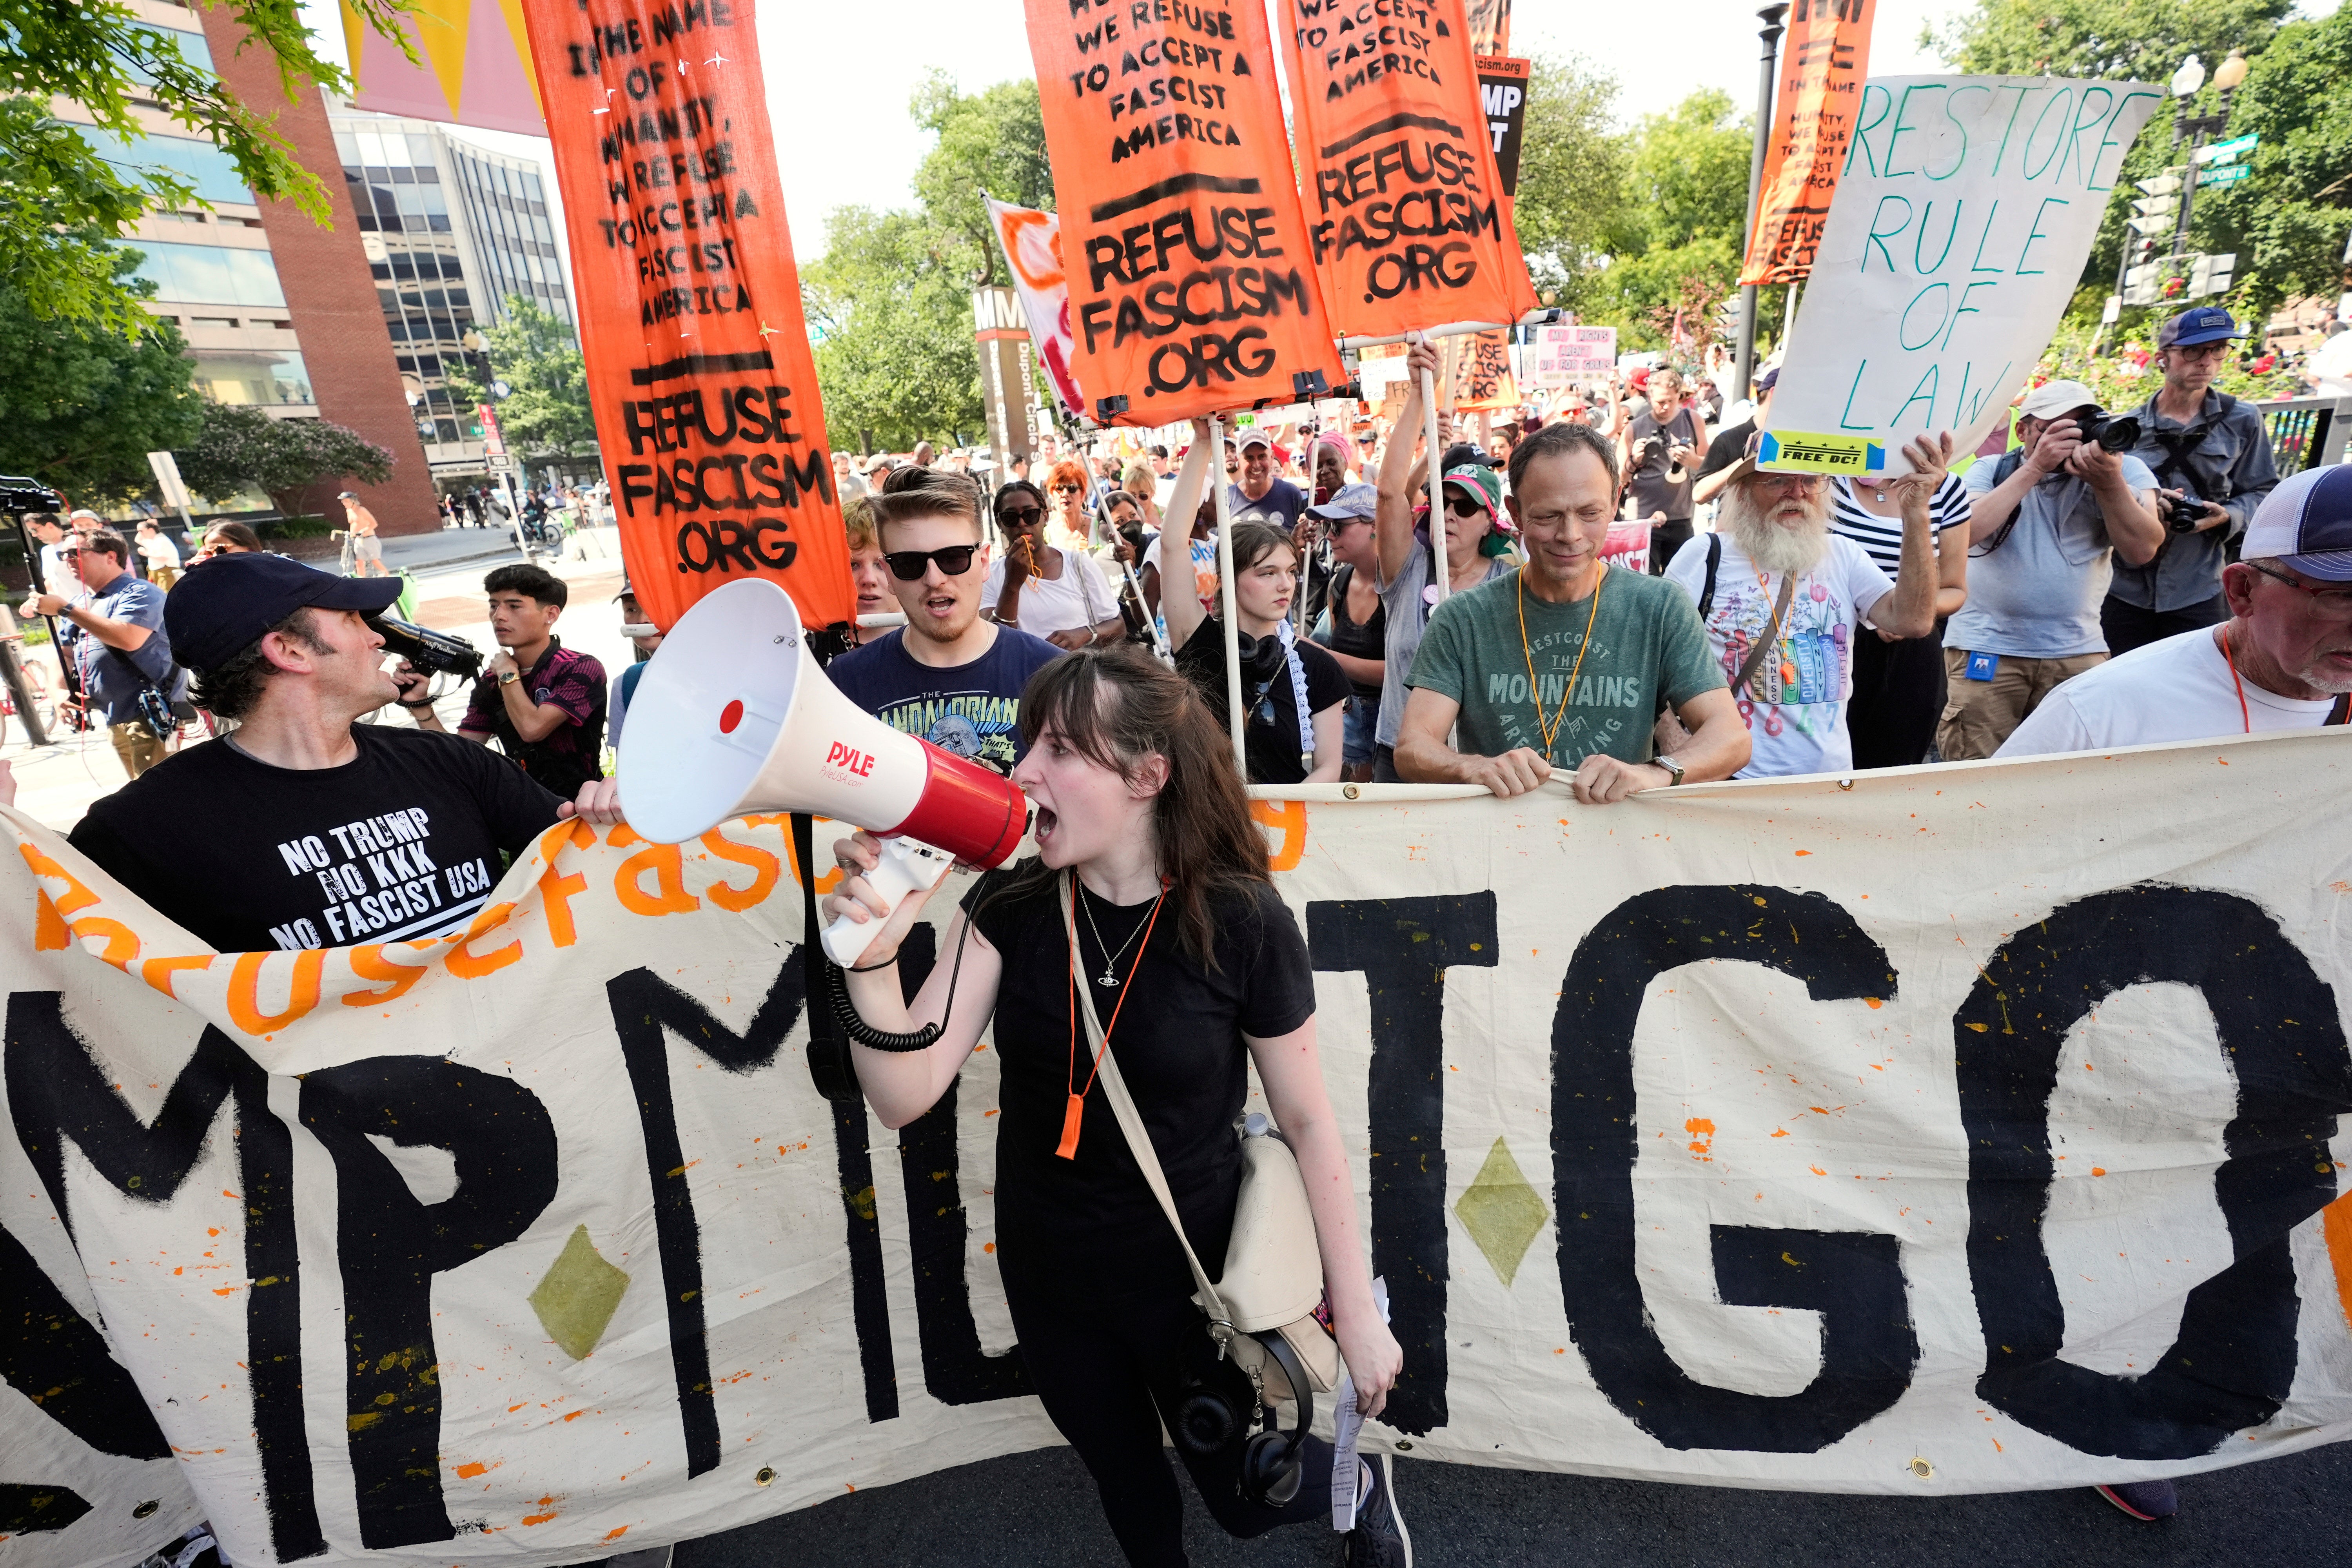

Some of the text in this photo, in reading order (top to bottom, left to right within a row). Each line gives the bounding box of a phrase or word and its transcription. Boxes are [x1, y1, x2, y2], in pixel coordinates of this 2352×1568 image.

[594, 18, 643, 61] THE
[652, 0, 734, 46] NAME
[1075, 14, 1121, 54] WE
[1131, 0, 1236, 40] REFUSE
[1297, 27, 1328, 51] TO
[1436, 19, 1450, 37] A
[1327, 25, 1431, 71] FASCIST
[626, 61, 666, 101] OF
[1070, 37, 1252, 98] TO ACCEPT A
[1326, 53, 1442, 103] AMERICA
[1109, 76, 1226, 122] FASCIST
[601, 96, 731, 165] HMANITY,
[1112, 113, 1241, 163] AMERICA
[1844, 84, 2163, 192] RESTORE
[608, 141, 737, 205] W REFUSE
[1316, 139, 1481, 215] REFUSE
[2200, 168, 2239, 183] DUPONT
[599, 218, 637, 249] TO
[734, 188, 759, 220] A
[1309, 187, 1502, 266] FASCISM
[1762, 218, 1827, 244] REFUS
[1862, 196, 2069, 276] RULE
[1083, 205, 1284, 293] REFUSE
[1363, 240, 1477, 303] .ORG
[642, 283, 752, 327] AMERICA
[973, 289, 996, 331] M
[993, 290, 1026, 328] M
[1080, 266, 1309, 355] FASCISM
[1900, 281, 1998, 352] OF
[1143, 326, 1276, 398] .ORG
[1460, 340, 1503, 360] FUSE
[1552, 330, 1608, 341] MY RIGHTS
[989, 340, 1004, 397] Dupont
[1018, 342, 1033, 397] Dupont
[1392, 382, 1410, 398] FR
[1455, 361, 1510, 379] SCISM
[1541, 360, 1610, 370] UP FOR GRABS
[623, 385, 801, 456] REFUSE
[1840, 359, 2012, 430] LAW
[996, 403, 1007, 446] Circle
[1025, 403, 1038, 446] Circle
[618, 449, 833, 518] FASCISM
[1782, 451, 1858, 465] FREE DC!
[677, 516, 798, 574] .ORG
[1552, 655, 1580, 667] THE
[1768, 648, 1778, 702] NDNESS
[1796, 638, 1815, 698] DIVERSITY
[1811, 639, 1823, 691] UNITY
[1822, 638, 1836, 697] COMPASSION
[1836, 639, 1846, 686] JUSTICE
[873, 696, 1020, 735] ANDAORIAN
[921, 690, 941, 699] THE
[1488, 673, 1640, 708] MOUNTAINS
[985, 739, 1012, 750] THAT'S
[819, 765, 864, 788] PyleUSA.com
[277, 807, 431, 876] NO TRUMP
[316, 840, 438, 904] NO KKK
[268, 858, 491, 951] NO FASCIST USA
[1550, 881, 2352, 1462] GO
